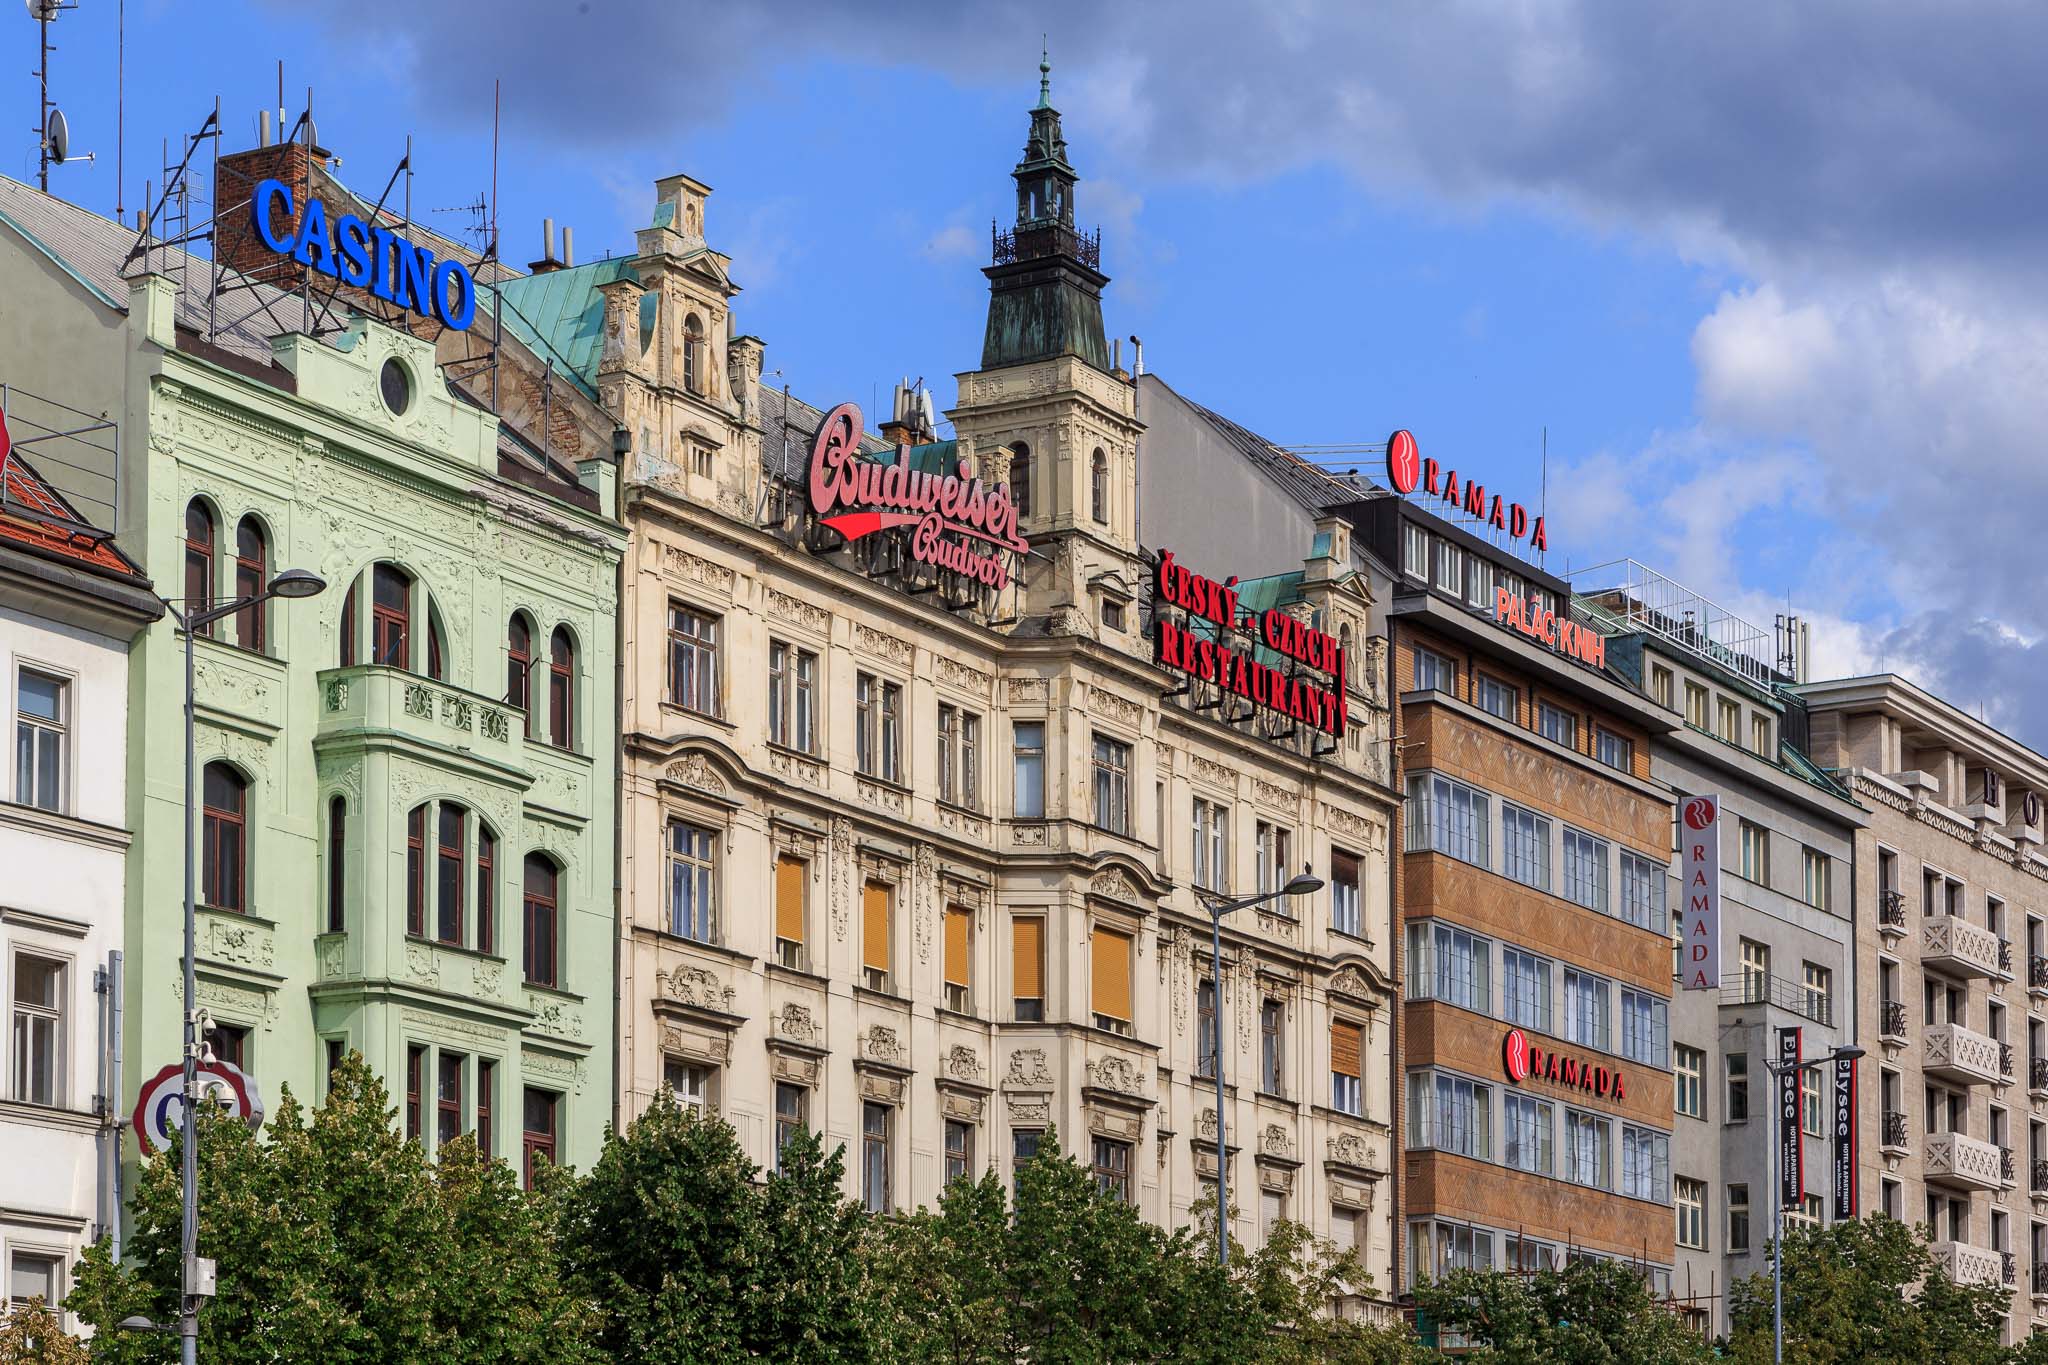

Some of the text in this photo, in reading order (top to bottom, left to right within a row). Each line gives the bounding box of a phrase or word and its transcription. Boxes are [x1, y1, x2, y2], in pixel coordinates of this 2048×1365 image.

[252, 178, 476, 331] CASINO
[809, 402, 1029, 553] Budweiser
[1423, 457, 1548, 552] RAMADA
[912, 512, 1011, 591] Budvar
[1157, 548, 1338, 677] ČESKÝ CZECH
[1494, 586, 1605, 669] PALÁC KNIH
[1159, 619, 1338, 735] RESTAURANT
[1690, 845, 1709, 986] RAMADA
[1531, 1047, 1626, 1100] RAMADA
[1836, 1059, 1850, 1136] Elysee
[1790, 1154, 1798, 1198] APARTMENTS
